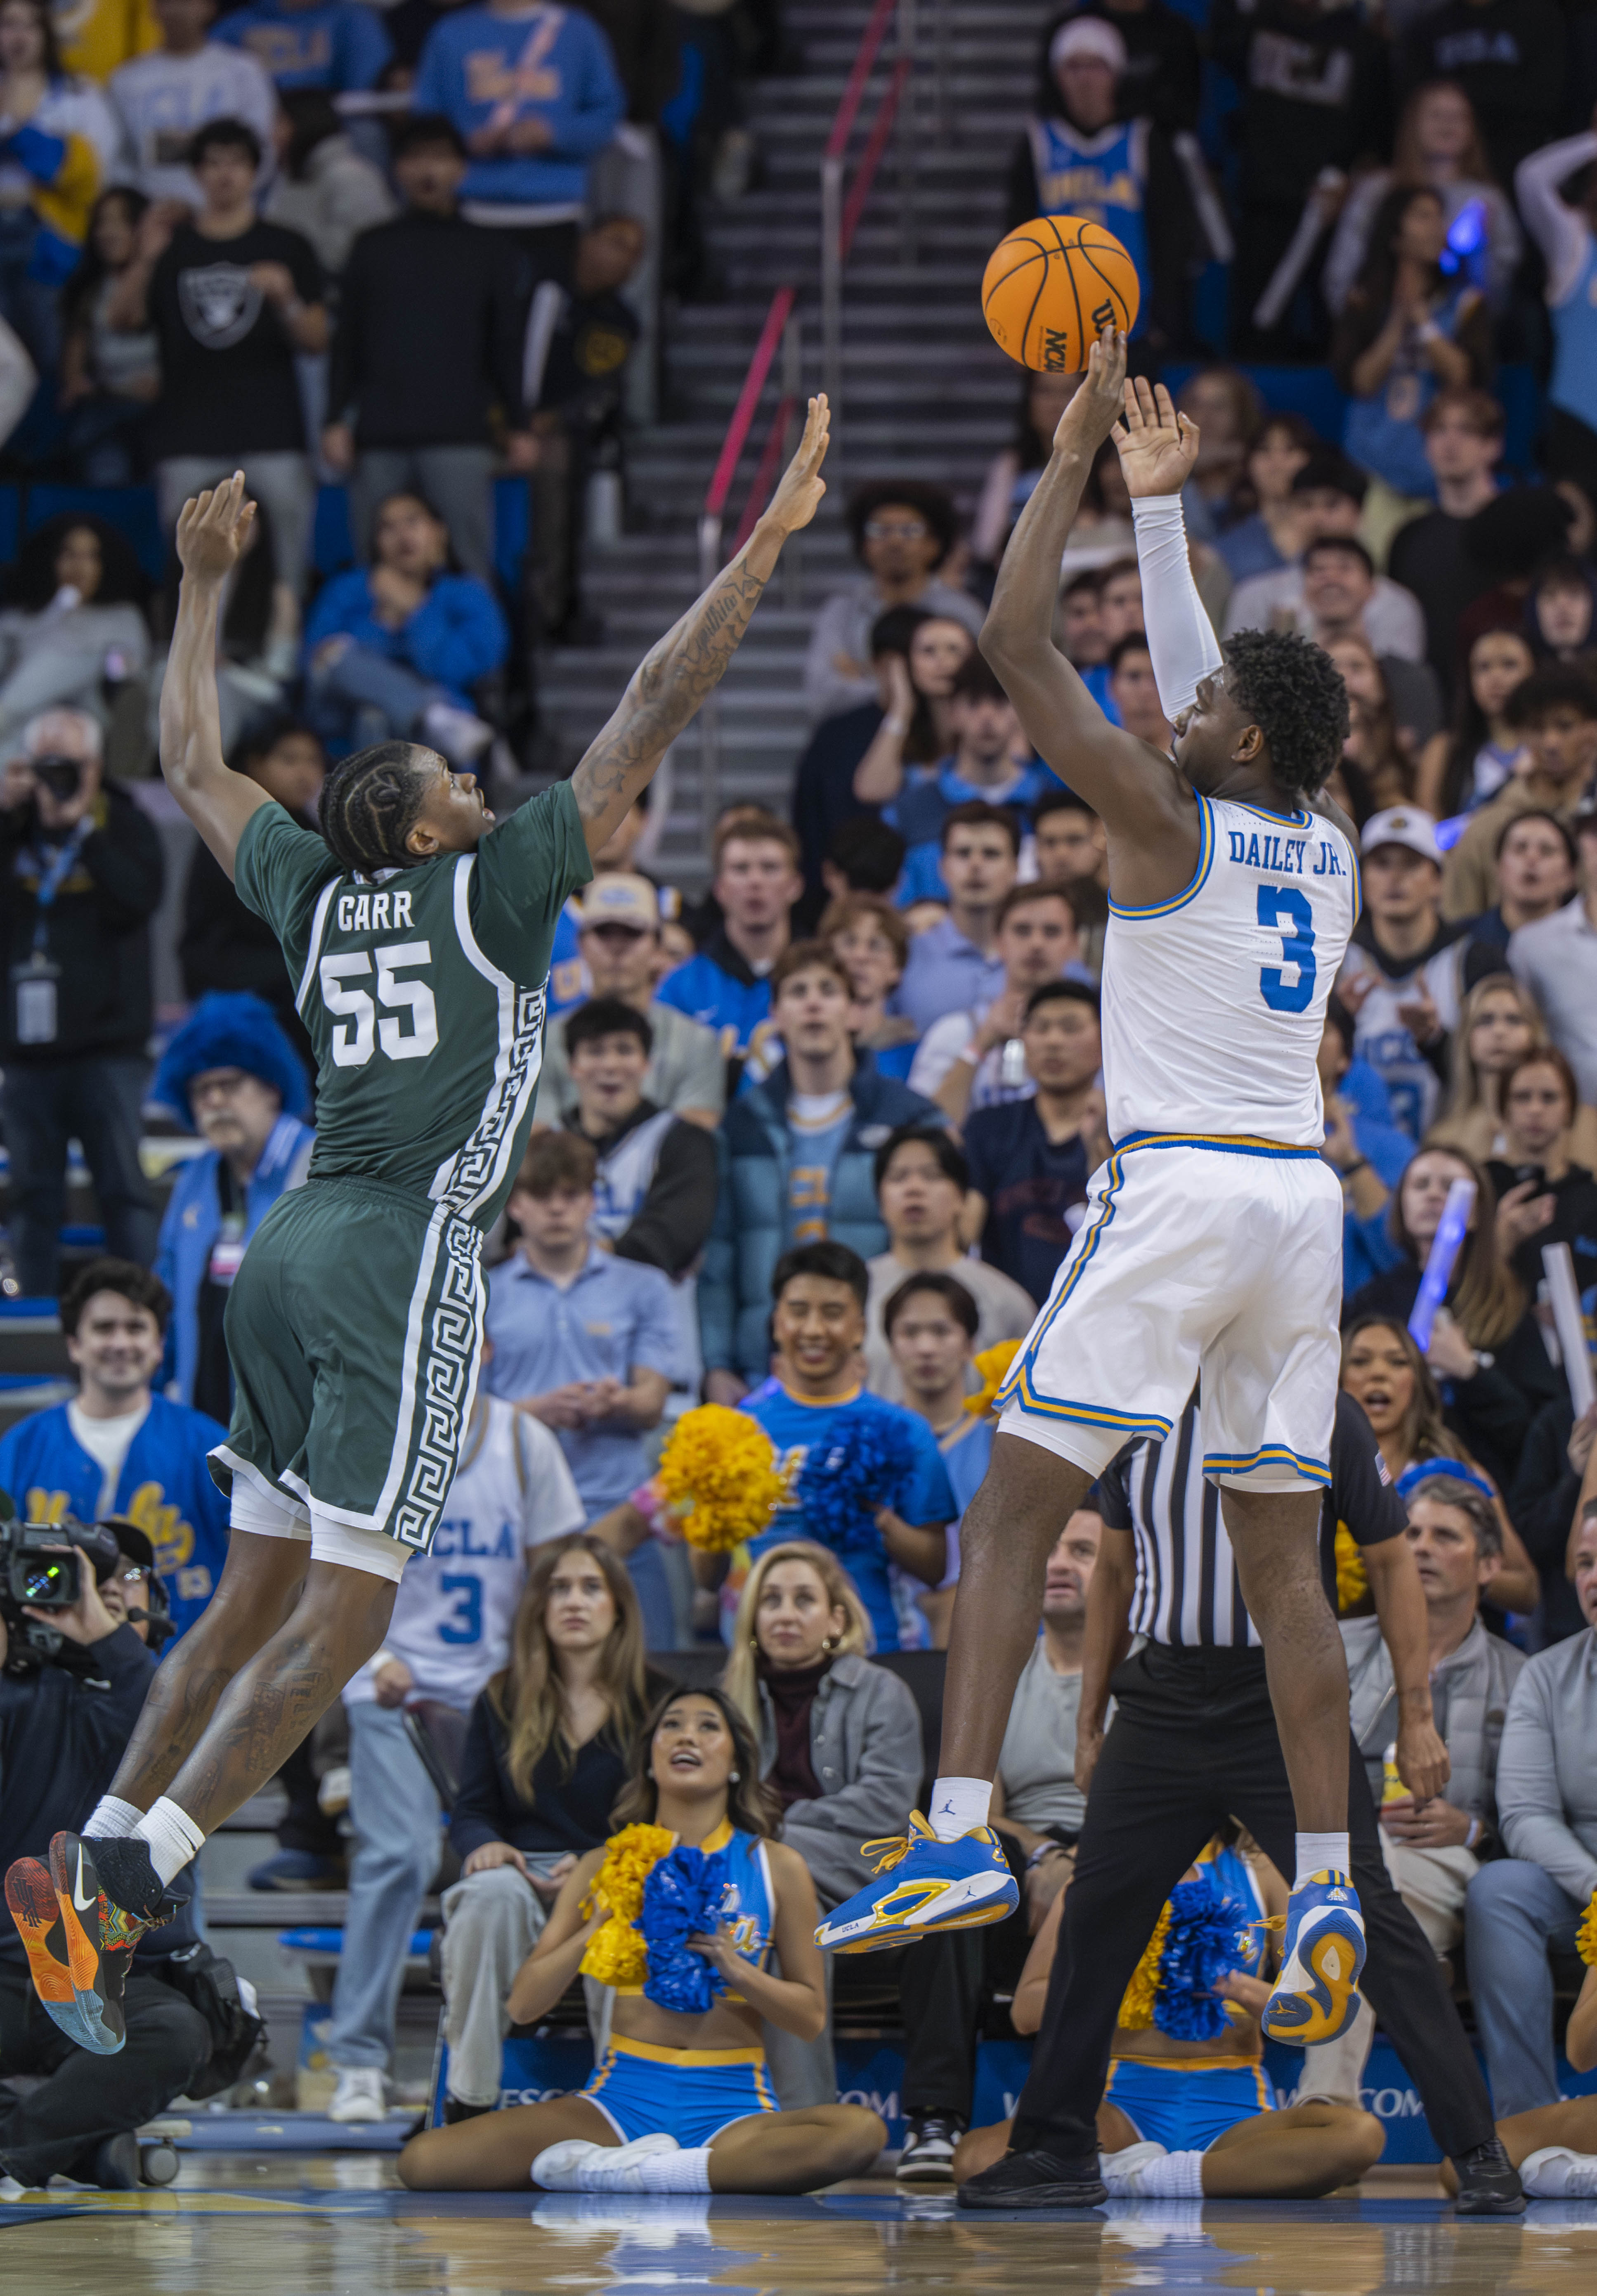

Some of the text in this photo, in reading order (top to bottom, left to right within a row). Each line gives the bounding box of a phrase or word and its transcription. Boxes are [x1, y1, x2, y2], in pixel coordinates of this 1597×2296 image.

[1228, 831, 1347, 876] DAILEY JR.
[338, 890, 416, 932] CARR
[1257, 884, 1316, 1013] 3
[319, 940, 440, 1067] 55
[407, 1519, 515, 1561] CLA
[437, 1573, 482, 1644] 3
[842, 1922, 859, 1933] UCLA
